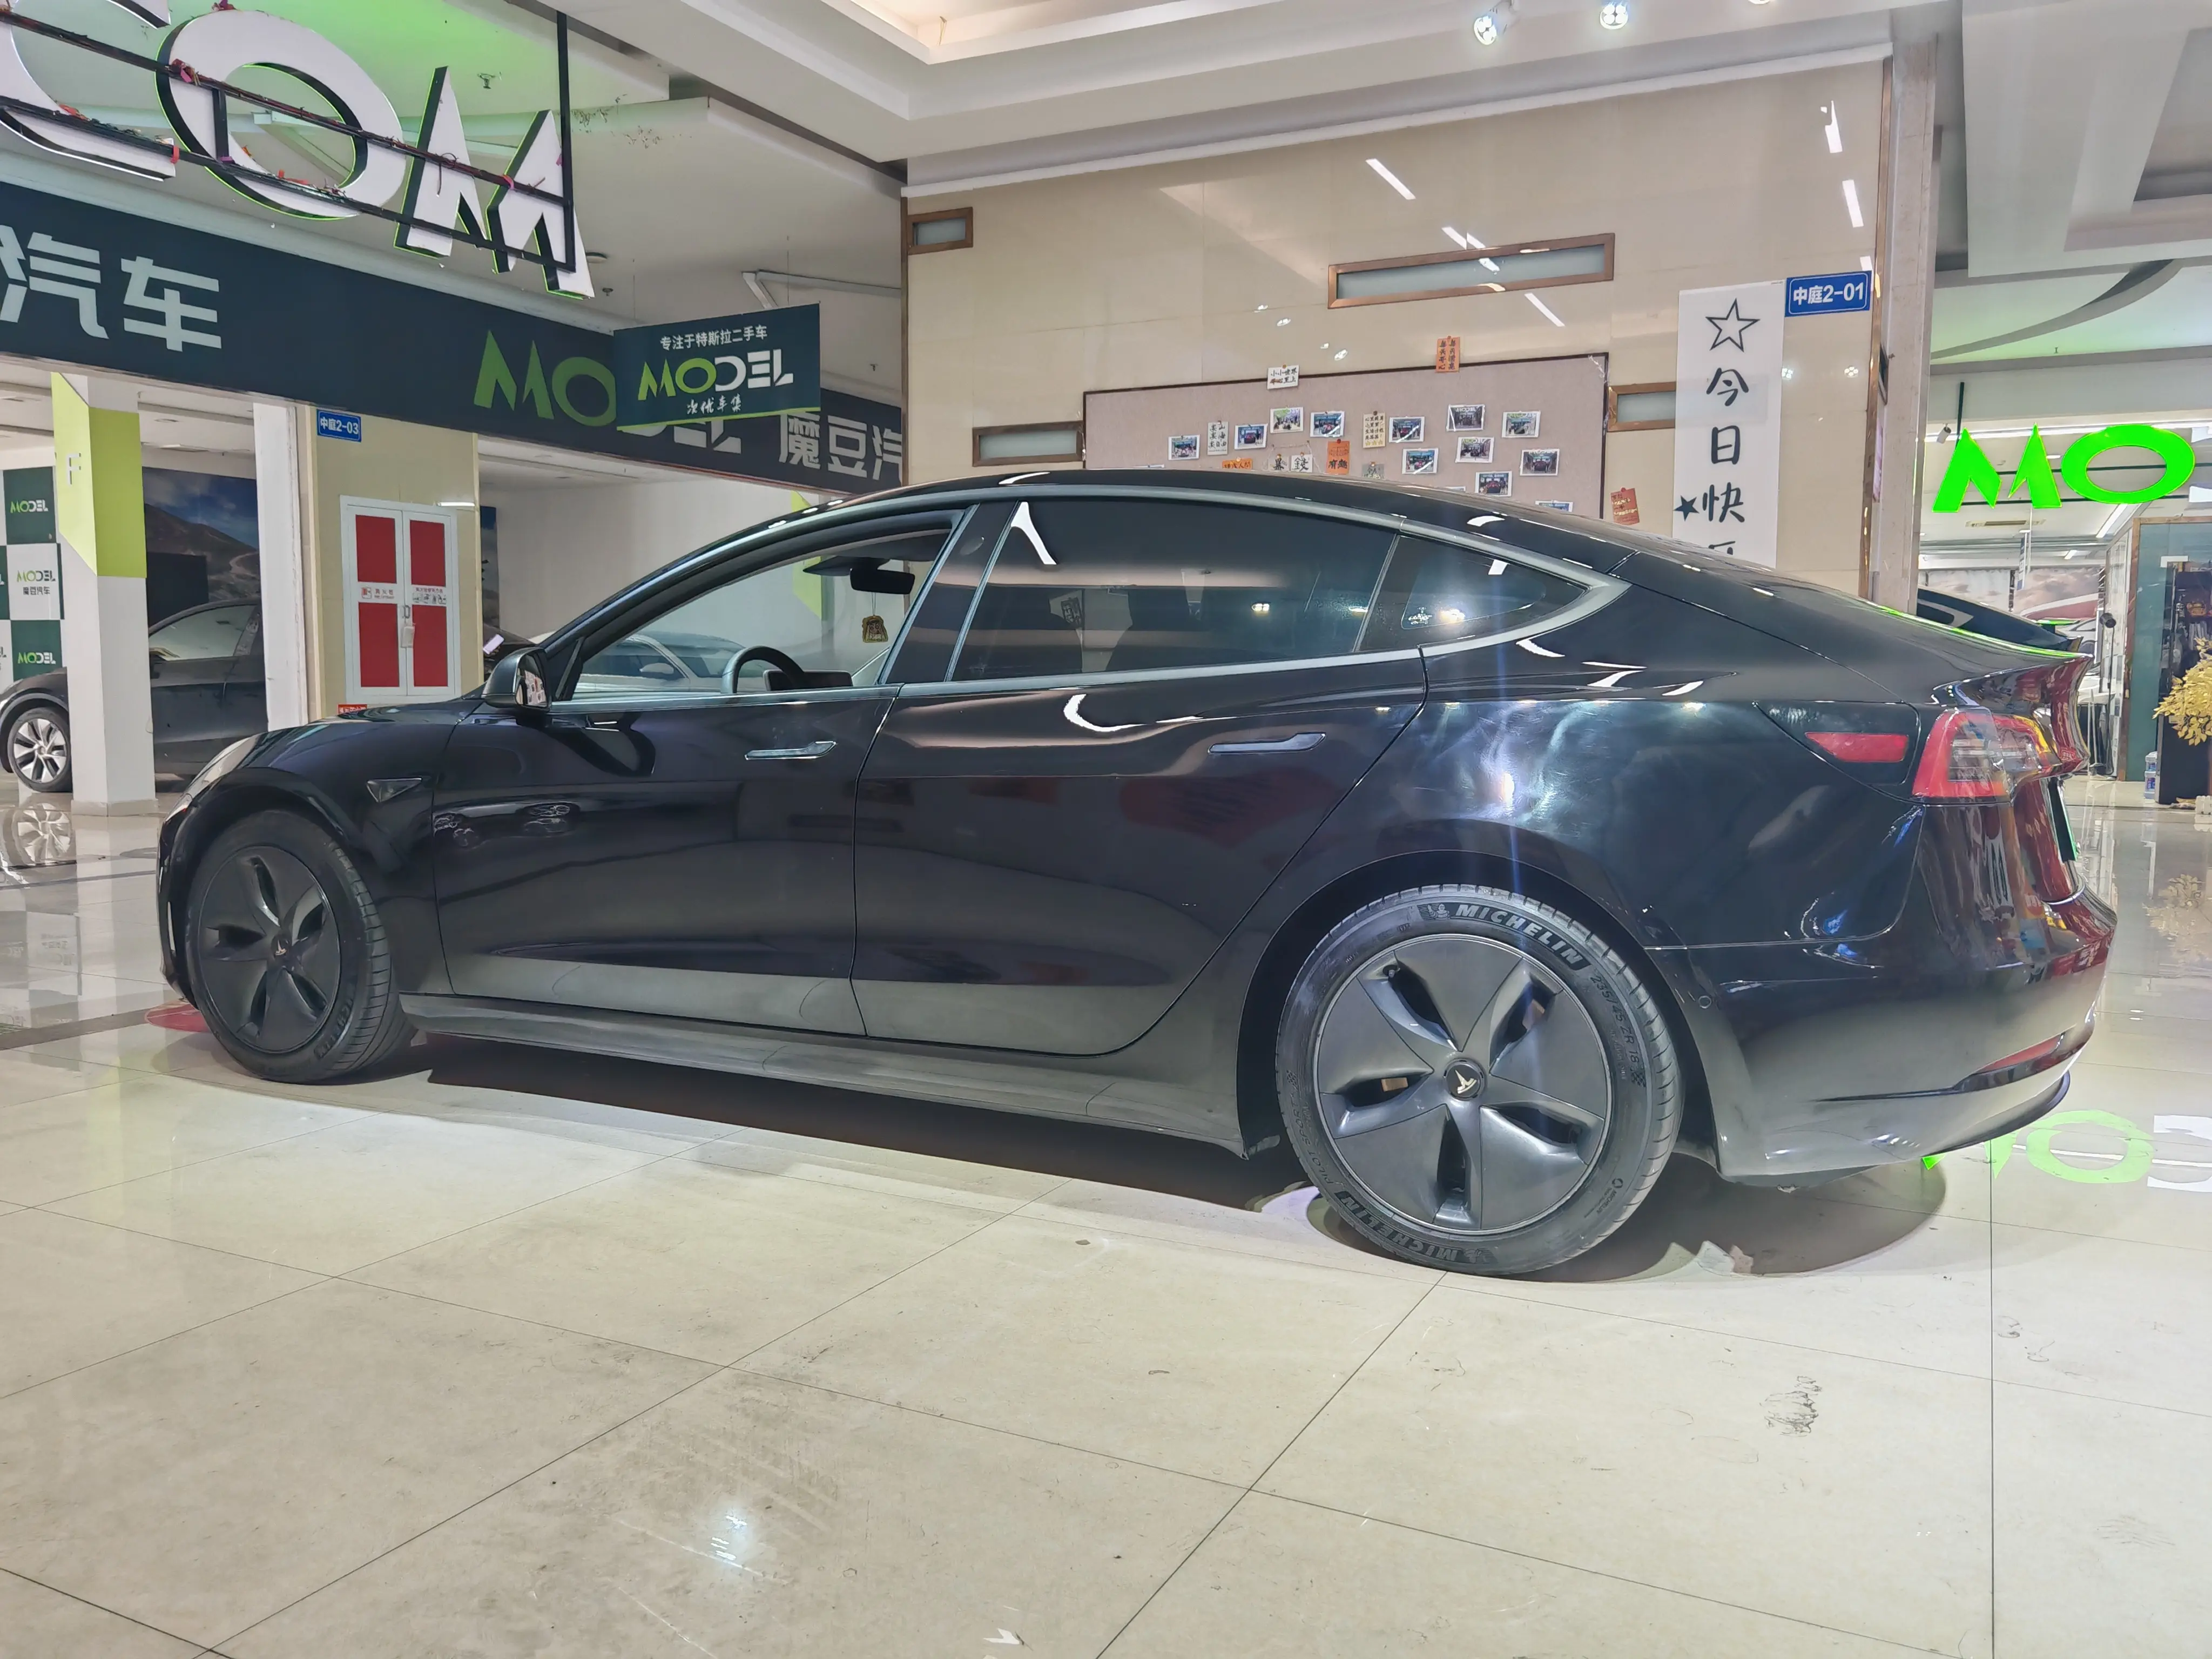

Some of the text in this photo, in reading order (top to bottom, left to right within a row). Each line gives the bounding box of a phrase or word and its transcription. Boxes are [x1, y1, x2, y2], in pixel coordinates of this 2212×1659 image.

[1793, 282, 1864, 305] 中庭2-01
[659, 324, 768, 350] 专注于特斯拉二手车
[638, 349, 794, 401] MODEL
[320, 416, 359, 435] 中庭2-03
[1932, 423, 2212, 512] MO
[10, 500, 49, 514] MODEL
[16, 570, 56, 583] MODEL
[17, 652, 56, 665] MODEL
[1455, 904, 1583, 965] MICHELIN
[1341, 1195, 1458, 1262] MICHELIN
